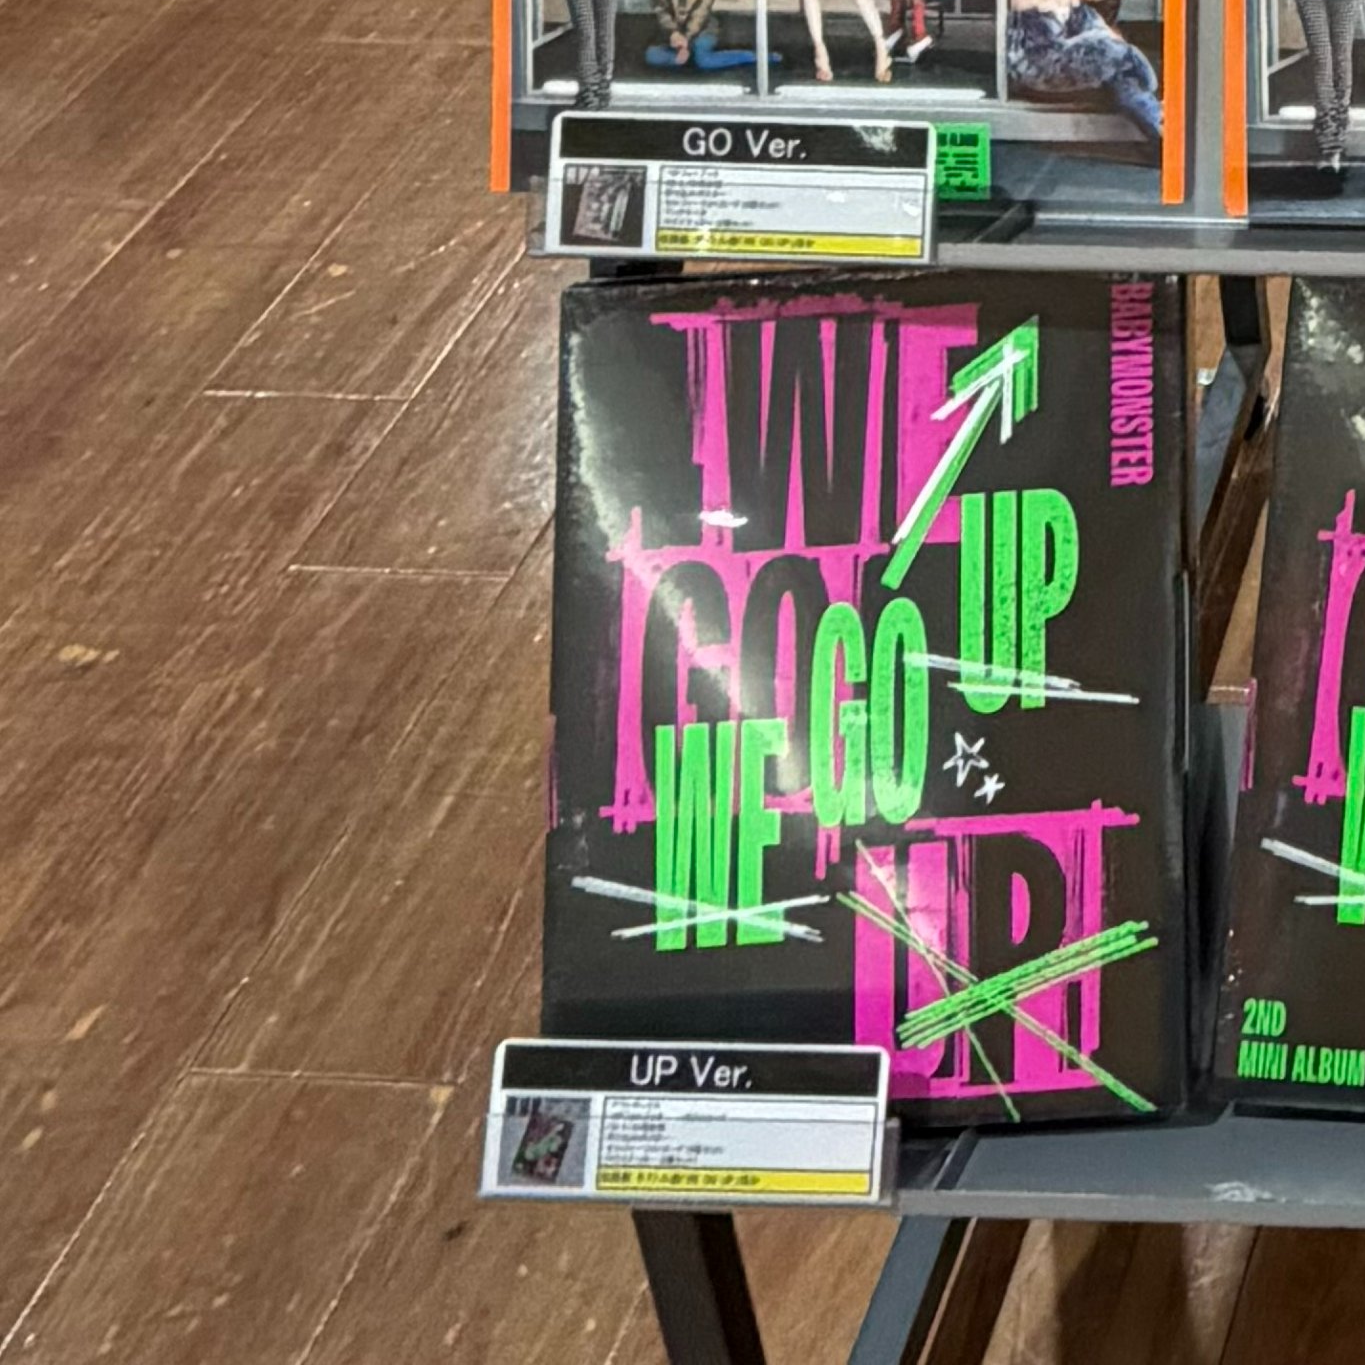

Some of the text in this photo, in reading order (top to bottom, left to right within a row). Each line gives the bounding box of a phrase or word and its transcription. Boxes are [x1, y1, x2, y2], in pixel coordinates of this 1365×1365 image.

[682, 126, 808, 161] GO Ver.
[1108, 282, 1155, 488] BABYMONSTER
[960, 487, 1080, 715] UP
[809, 596, 929, 828] GO
[654, 718, 790, 951] WE
[630, 1053, 754, 1089] UP Ver.
[1237, 1039, 1289, 1081] MINI
[1241, 998, 1287, 1037] 2ND
